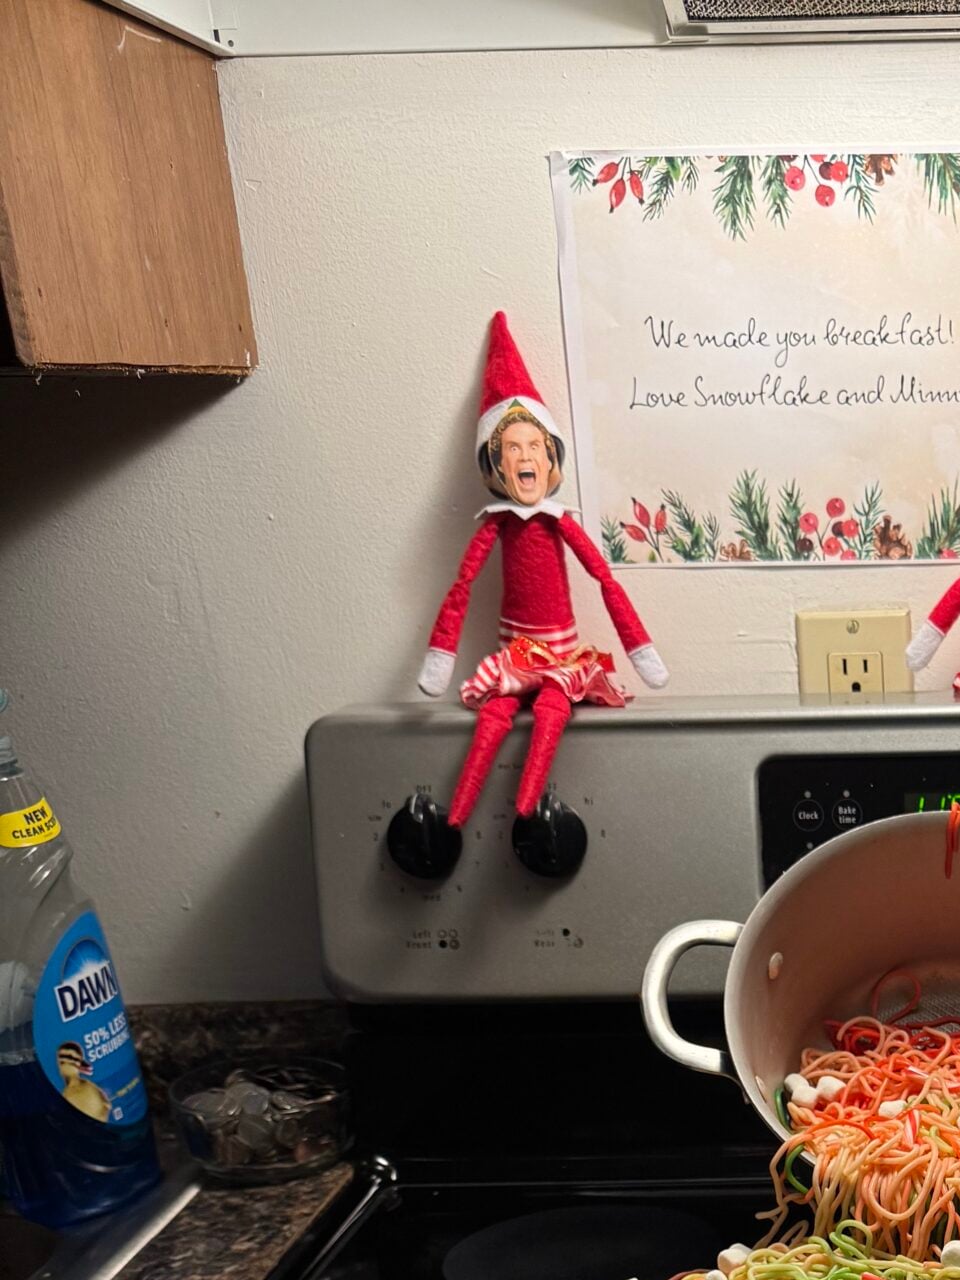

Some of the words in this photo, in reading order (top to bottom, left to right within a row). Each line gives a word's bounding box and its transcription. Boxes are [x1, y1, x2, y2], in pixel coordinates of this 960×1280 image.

[644, 315, 688, 349] We
[694, 317, 771, 349] made
[776, 329, 817, 368] you
[823, 312, 956, 348] breakfast!
[629, 376, 689, 410] Love
[694, 374, 831, 408] Snowflake
[836, 375, 884, 406] and
[24, 807, 49, 826] NEW
[797, 810, 819, 820] Clock
[837, 805, 857, 815] Bake
[838, 815, 857, 824] time
[11, 824, 46, 839] CLEAN
[57, 964, 118, 1019] DAWN
[84, 1026, 110, 1049] 50%
